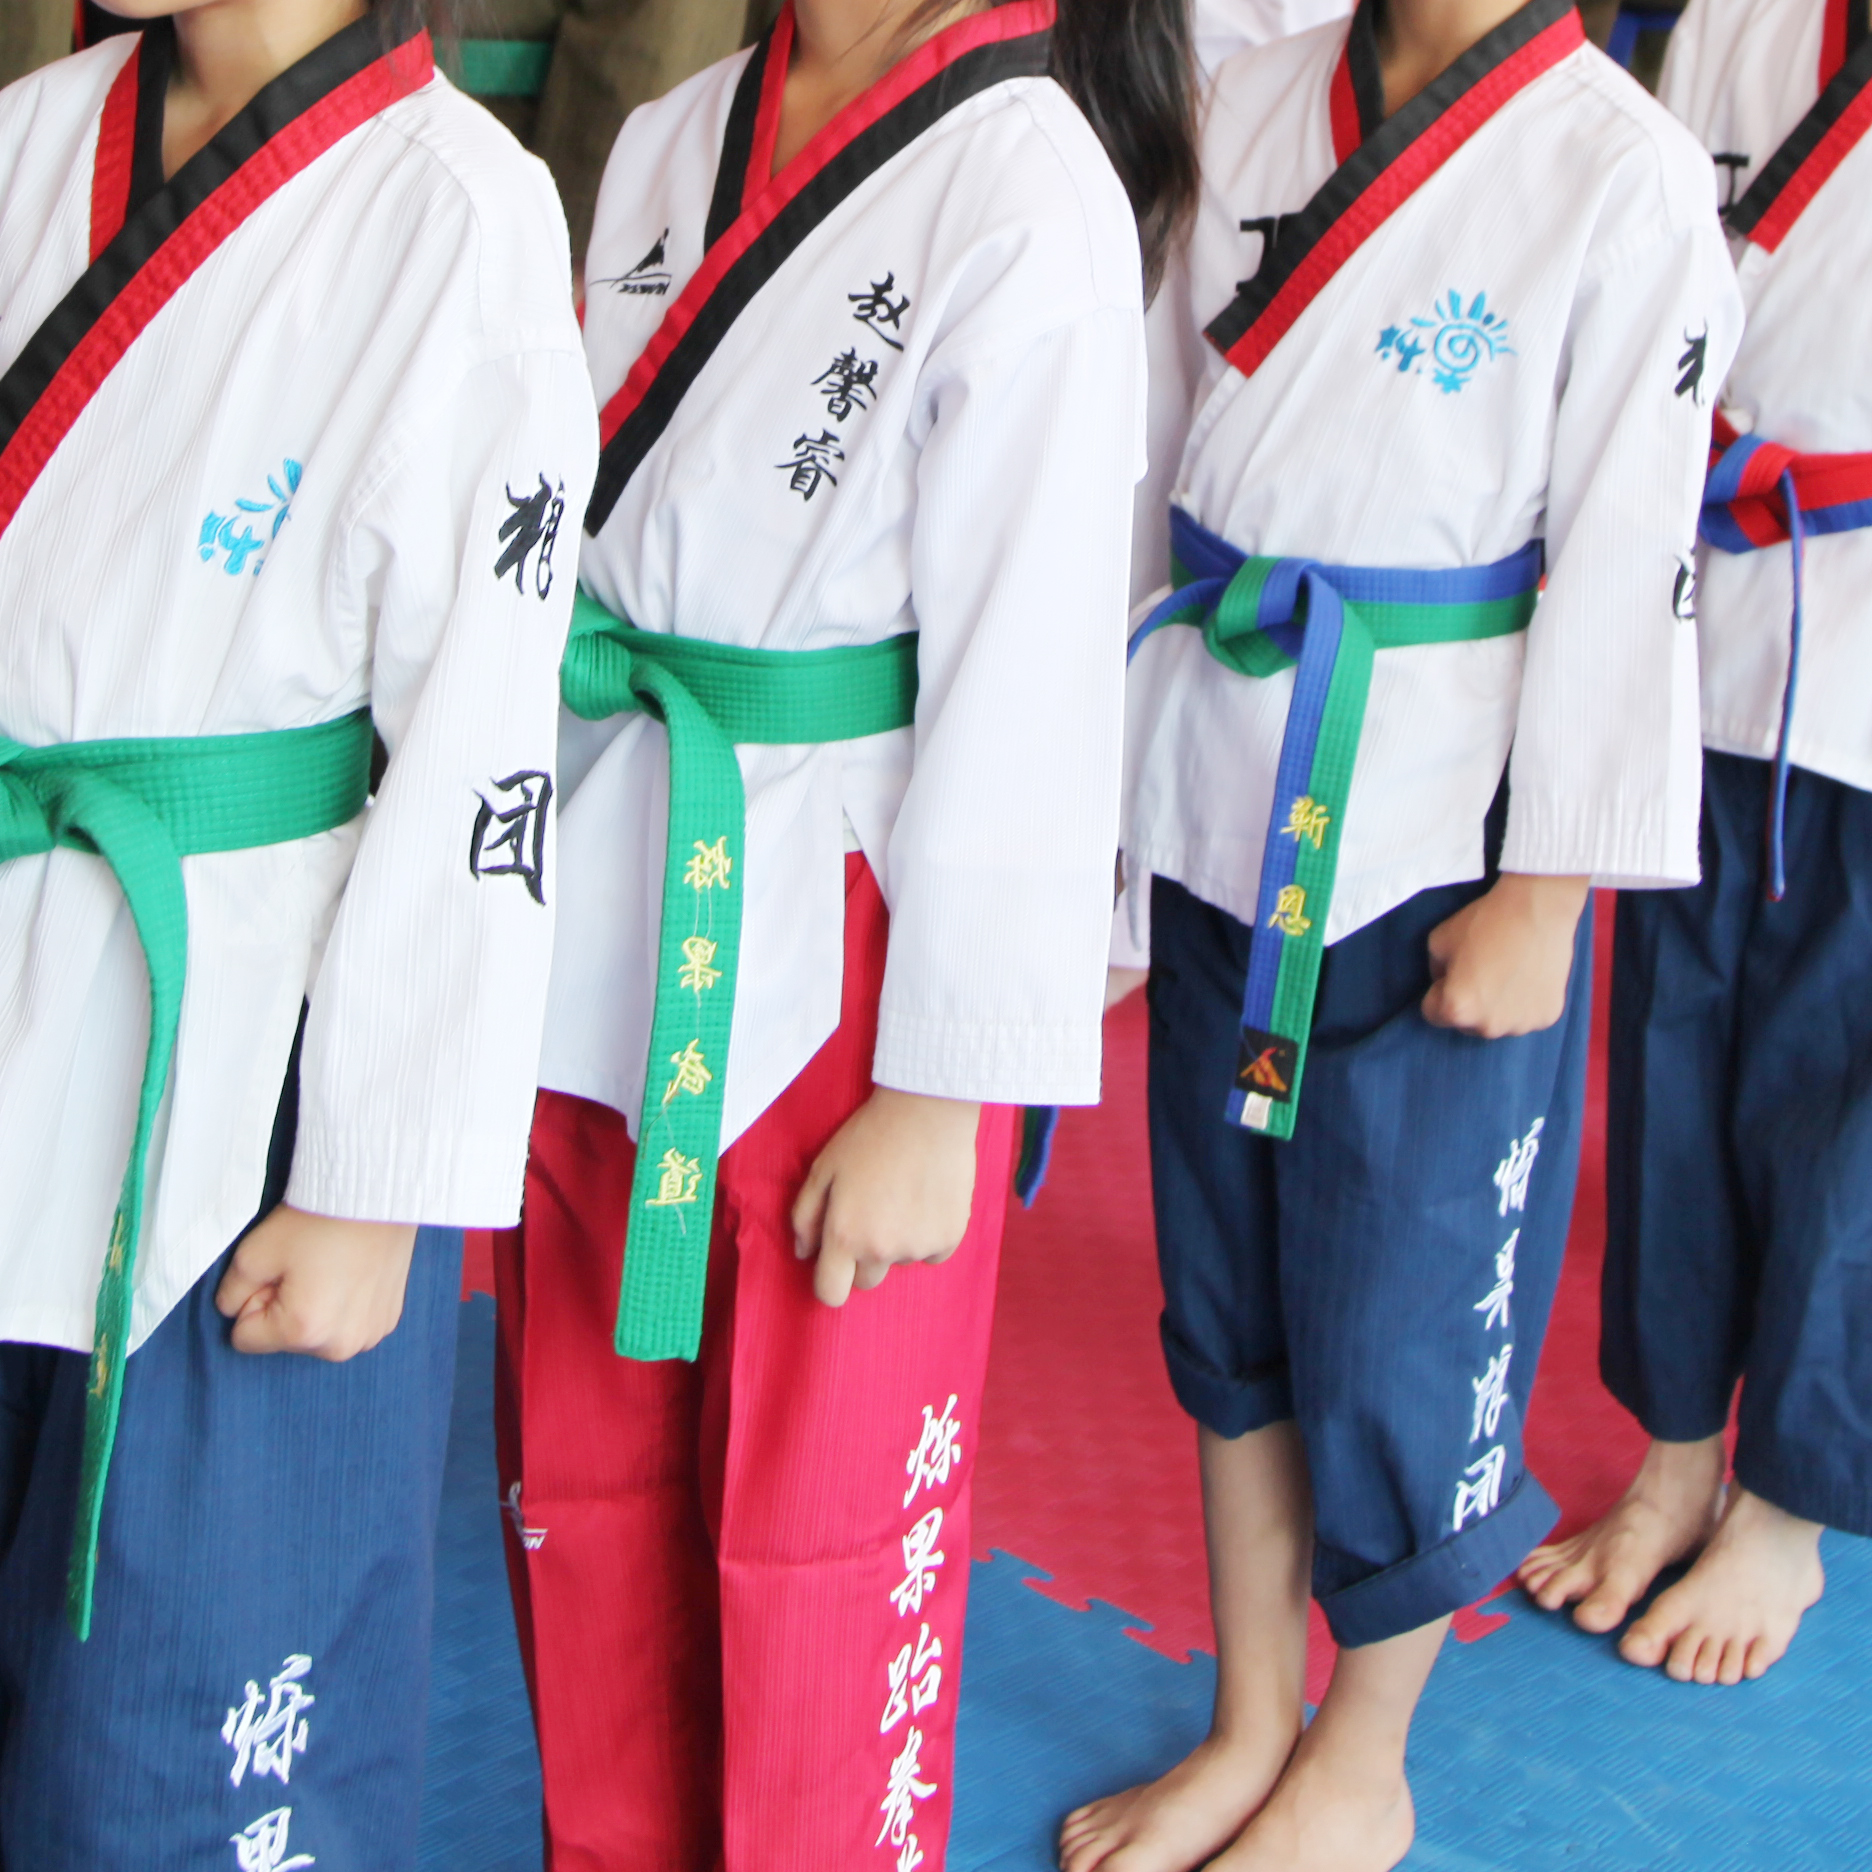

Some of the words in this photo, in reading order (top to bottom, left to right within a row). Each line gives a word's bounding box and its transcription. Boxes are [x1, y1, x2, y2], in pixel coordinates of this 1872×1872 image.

[774, 270, 910, 503] 赵馨睿
[874, 1393, 963, 1872] 烁果跆拳
